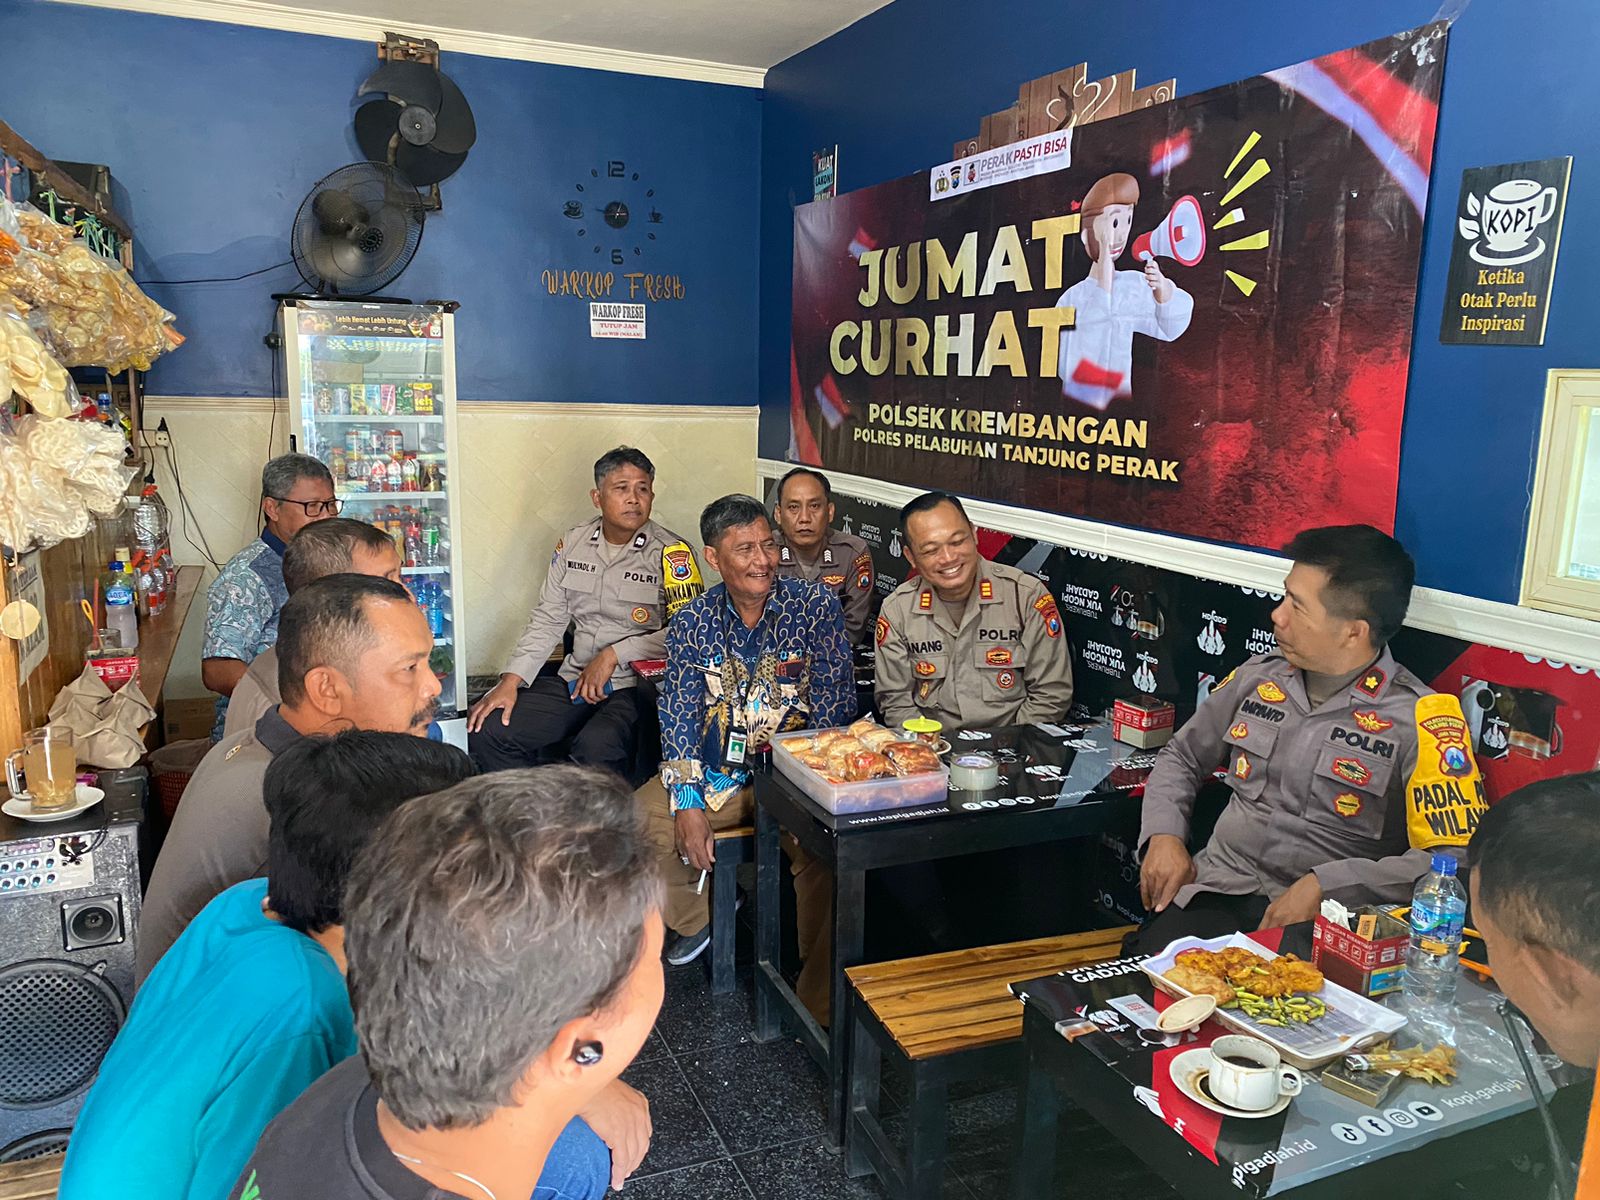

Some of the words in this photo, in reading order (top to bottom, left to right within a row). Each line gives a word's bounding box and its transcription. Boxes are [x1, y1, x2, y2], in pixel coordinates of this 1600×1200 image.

[981, 151, 1013, 172] PERAK
[1013, 143, 1042, 164] PASTI
[1044, 136, 1067, 156] BISA
[607, 161, 625, 178] 12
[1487, 206, 1536, 236] KOPI
[611, 249, 624, 265] 6
[857, 213, 1081, 308] JUMAT
[541, 269, 614, 299] WARKOP
[1477, 268, 1525, 286] Ketika
[1460, 292, 1494, 309] Otak
[1496, 292, 1537, 308] Perlu
[592, 304, 622, 318] WARKOP
[622, 305, 644, 319] FRESH
[1460, 314, 1525, 334] Inspirasi
[829, 306, 1076, 378] CURHAT
[869, 402, 945, 430] POLSEK
[951, 408, 1148, 448] KREMBANGAN
[853, 428, 901, 447] POLRES
[904, 432, 997, 460] PELABUHAN
[1002, 443, 1090, 471] TANJUNG
[1097, 454, 1180, 482] PERAK
[624, 571, 658, 584] POLRI
[1061, 592, 1085, 609] NGOPI
[1065, 583, 1100, 600] GADJAH!
[1086, 598, 1103, 612] YUK
[979, 628, 1022, 641] POLRI
[1087, 640, 1123, 660] GADJAH!
[1245, 639, 1274, 655] GOPI
[1082, 648, 1108, 667] NGOPI
[1108, 655, 1126, 672] YUK
[1331, 726, 1395, 759] POLRI
[1413, 781, 1472, 813] PADAL
[848, 807, 950, 825] www.kopigadjah.id
[1441, 1078, 1525, 1110] kopi.gadjah
[1231, 1138, 1318, 1190] pigadjah.id
